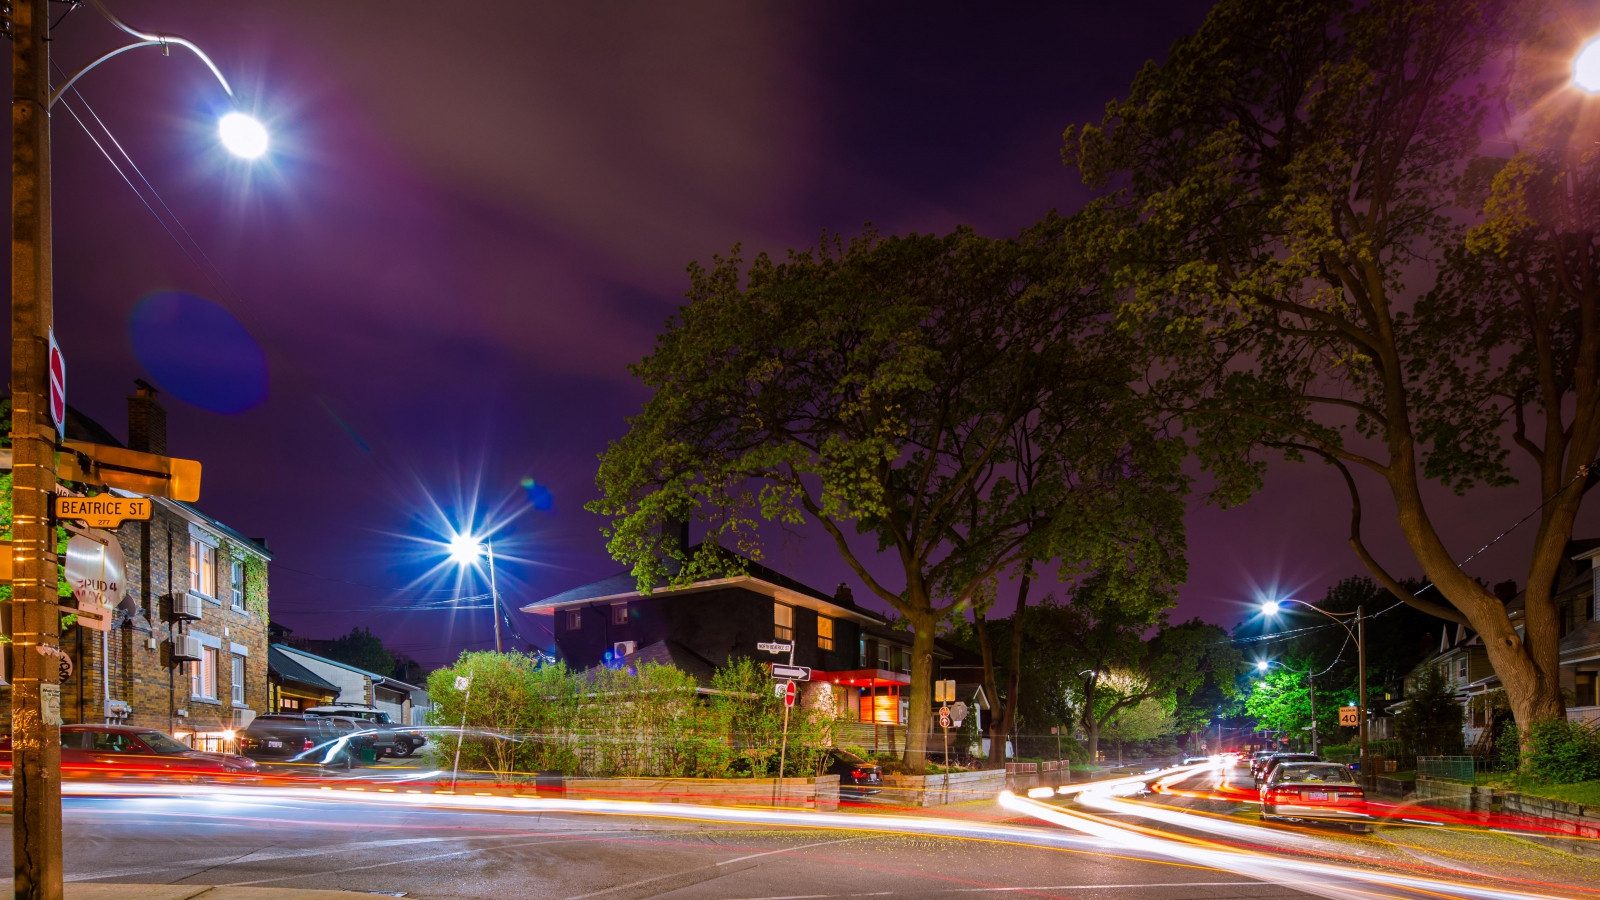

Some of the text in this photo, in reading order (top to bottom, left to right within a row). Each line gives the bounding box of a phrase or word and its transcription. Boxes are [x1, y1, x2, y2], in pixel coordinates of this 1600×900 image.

[61, 501, 122, 515] BEATRICE
[109, 582, 117, 592] 4
[1342, 714, 1356, 723] 40
